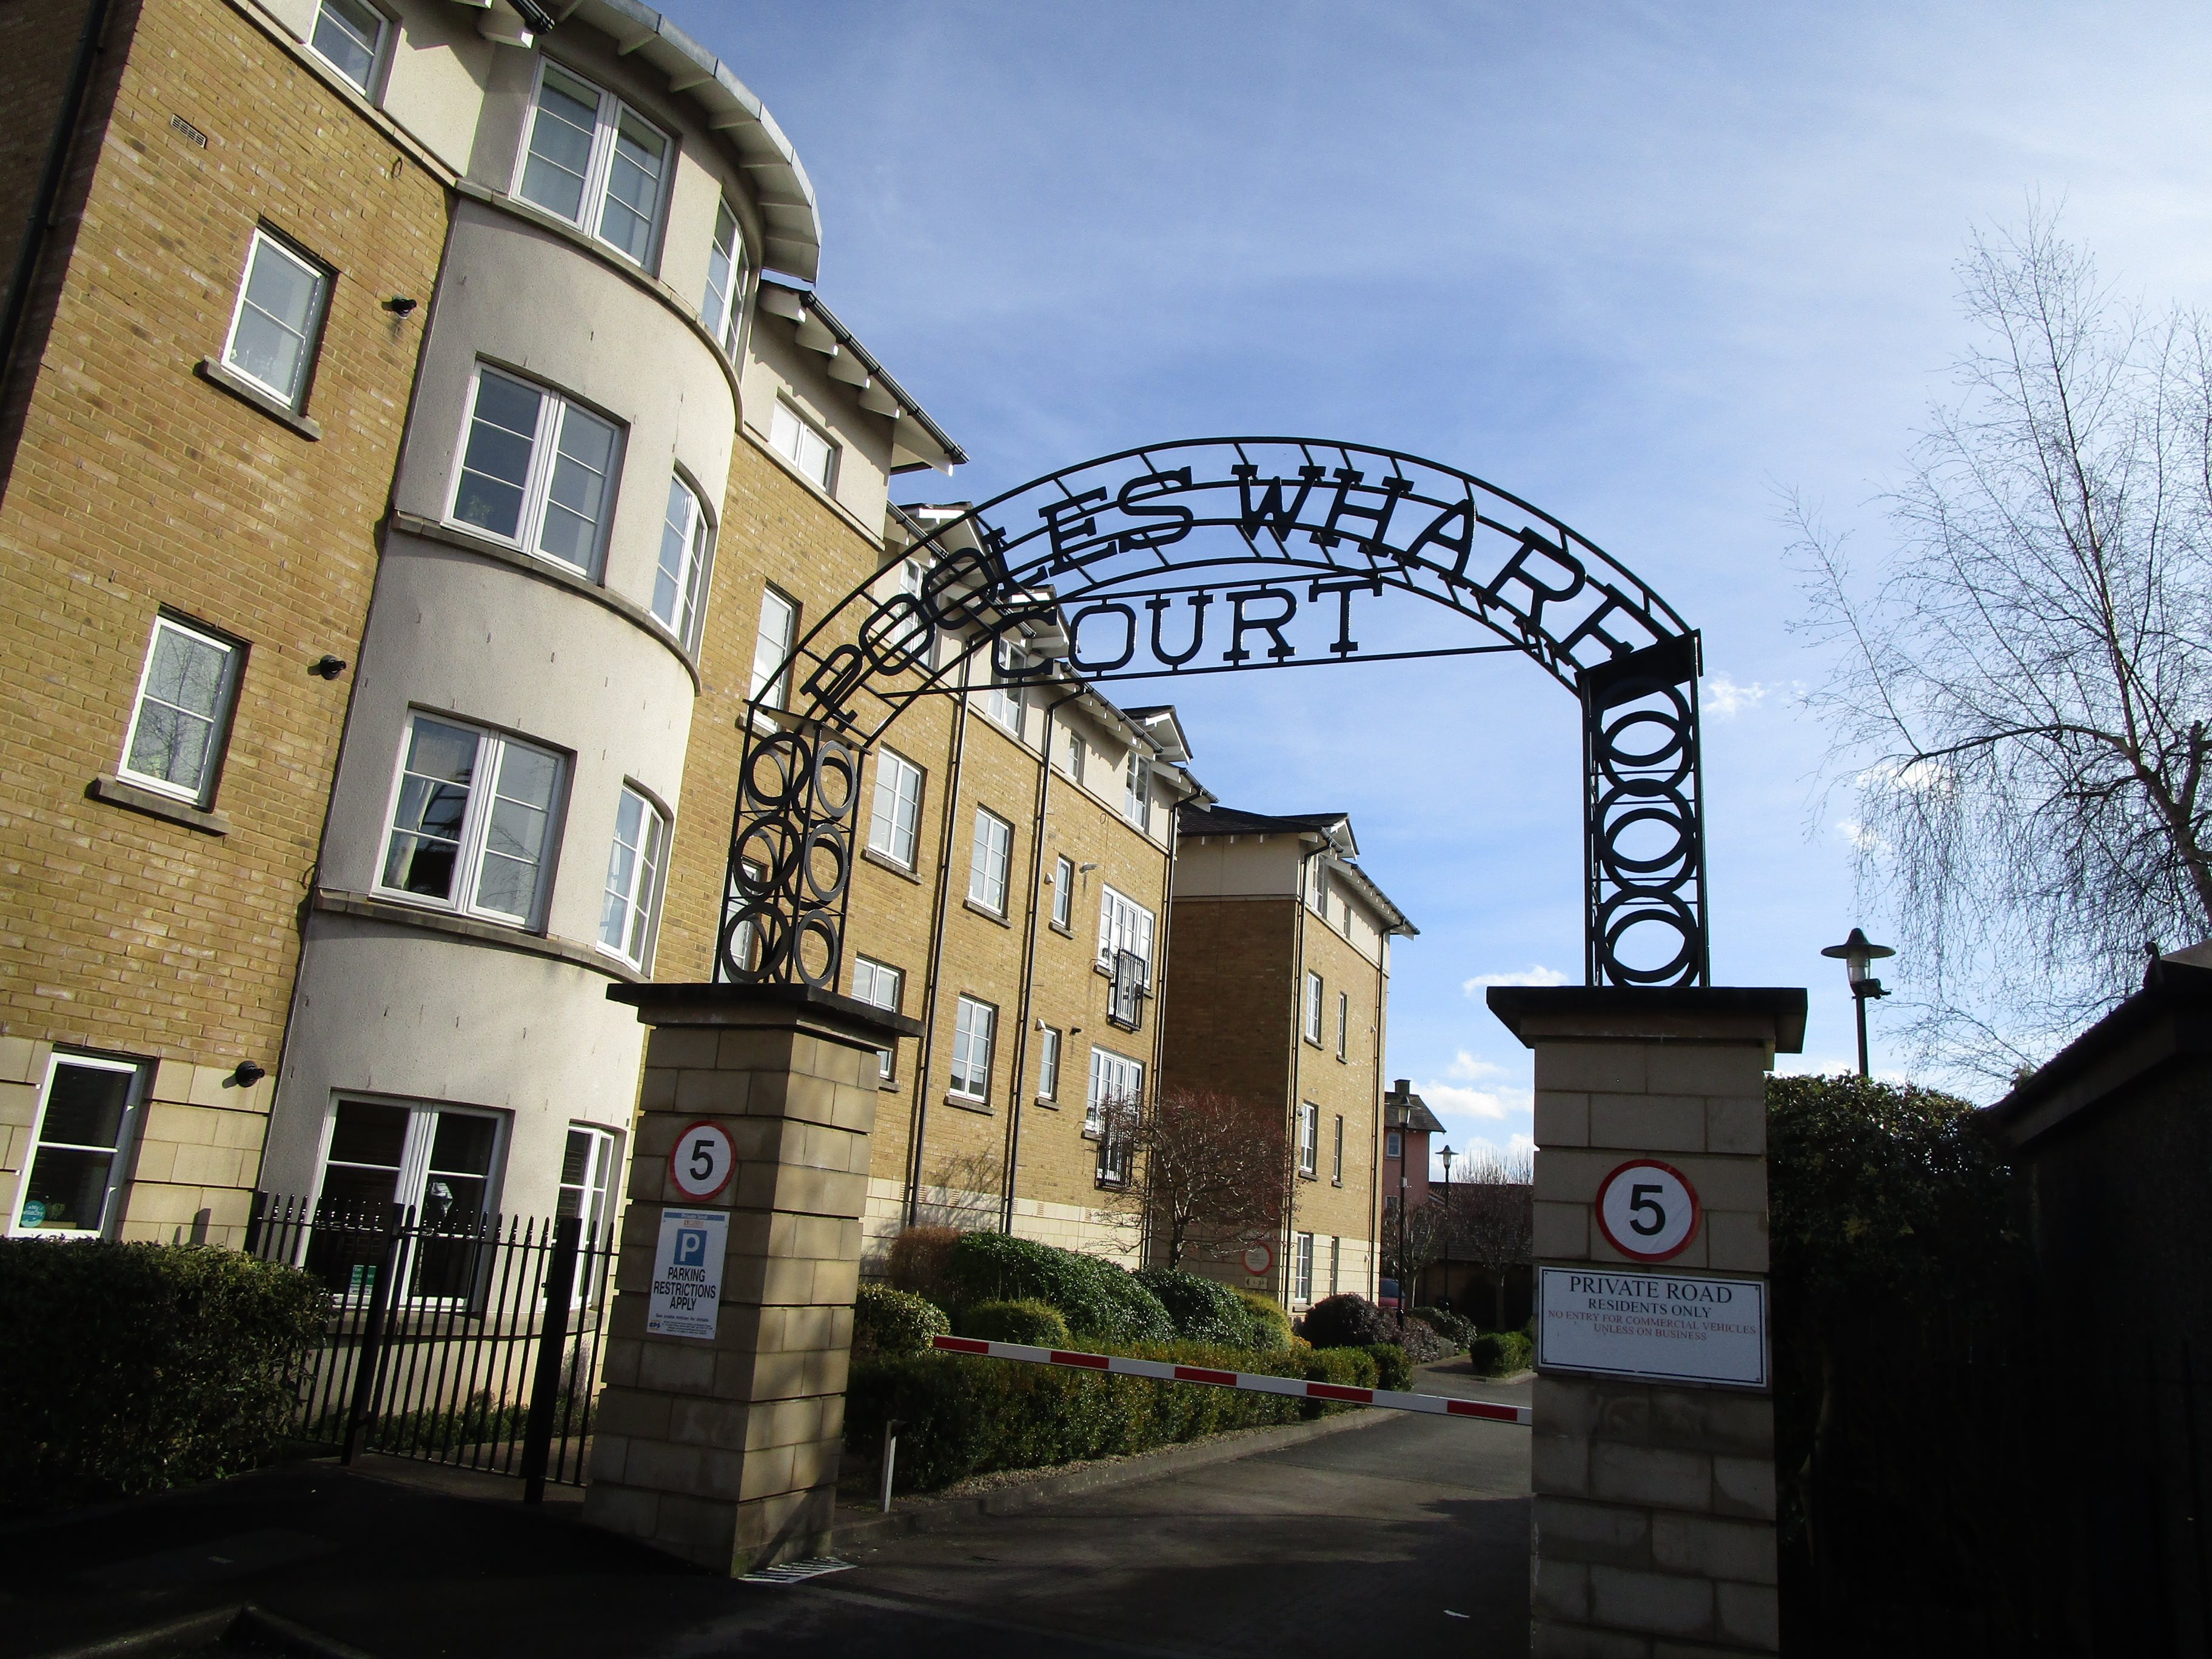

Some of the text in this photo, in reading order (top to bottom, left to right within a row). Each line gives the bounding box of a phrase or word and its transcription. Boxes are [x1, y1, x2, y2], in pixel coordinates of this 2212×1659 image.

[799, 464, 1677, 734] POOLES WHARF
[990, 574, 1382, 678] COURT
[689, 1139, 715, 1181] 5
[1629, 1184, 1666, 1236] 5
[668, 1267, 706, 1282] PARKING
[654, 1281, 716, 1298] RESTRICTIONS
[1570, 1275, 1732, 1303] PRIVATE ROAD
[669, 1296, 697, 1311] APPLY
[1589, 1298, 1712, 1318] RESIDENTS ONLY
[1548, 1309, 1756, 1334] NO ENTRY FOR COMMERCIAL VEHICLES
[1594, 1323, 1708, 1341] UNLESS ON BUSINESS
